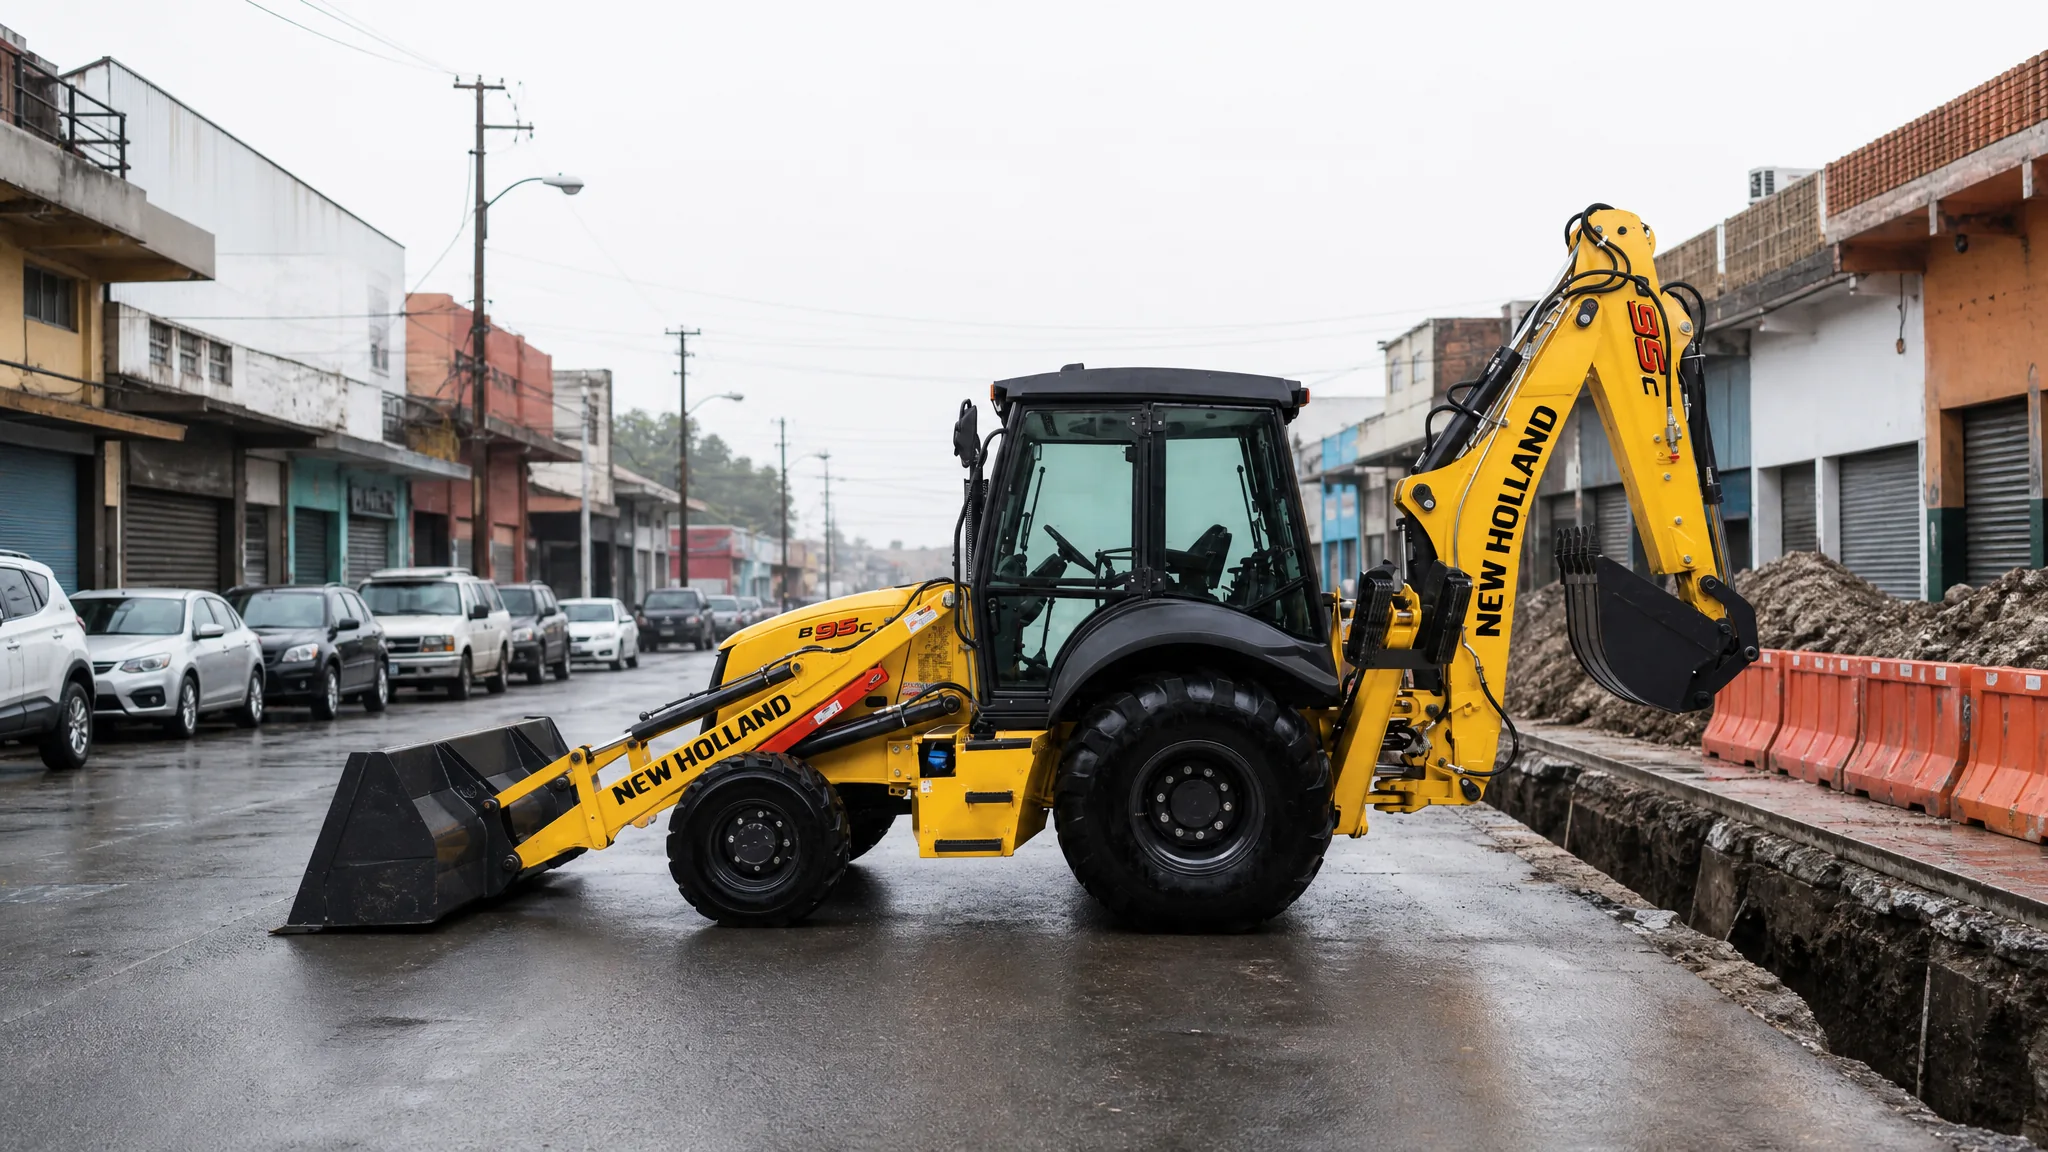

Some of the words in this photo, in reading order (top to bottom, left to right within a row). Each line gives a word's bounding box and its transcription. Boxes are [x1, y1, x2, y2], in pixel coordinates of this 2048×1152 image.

[1486, 405, 1557, 553] HOLLAND
[1476, 560, 1507, 637] NEW
[612, 759, 672, 805] NEW
[673, 694, 791, 772] HOLLAND
